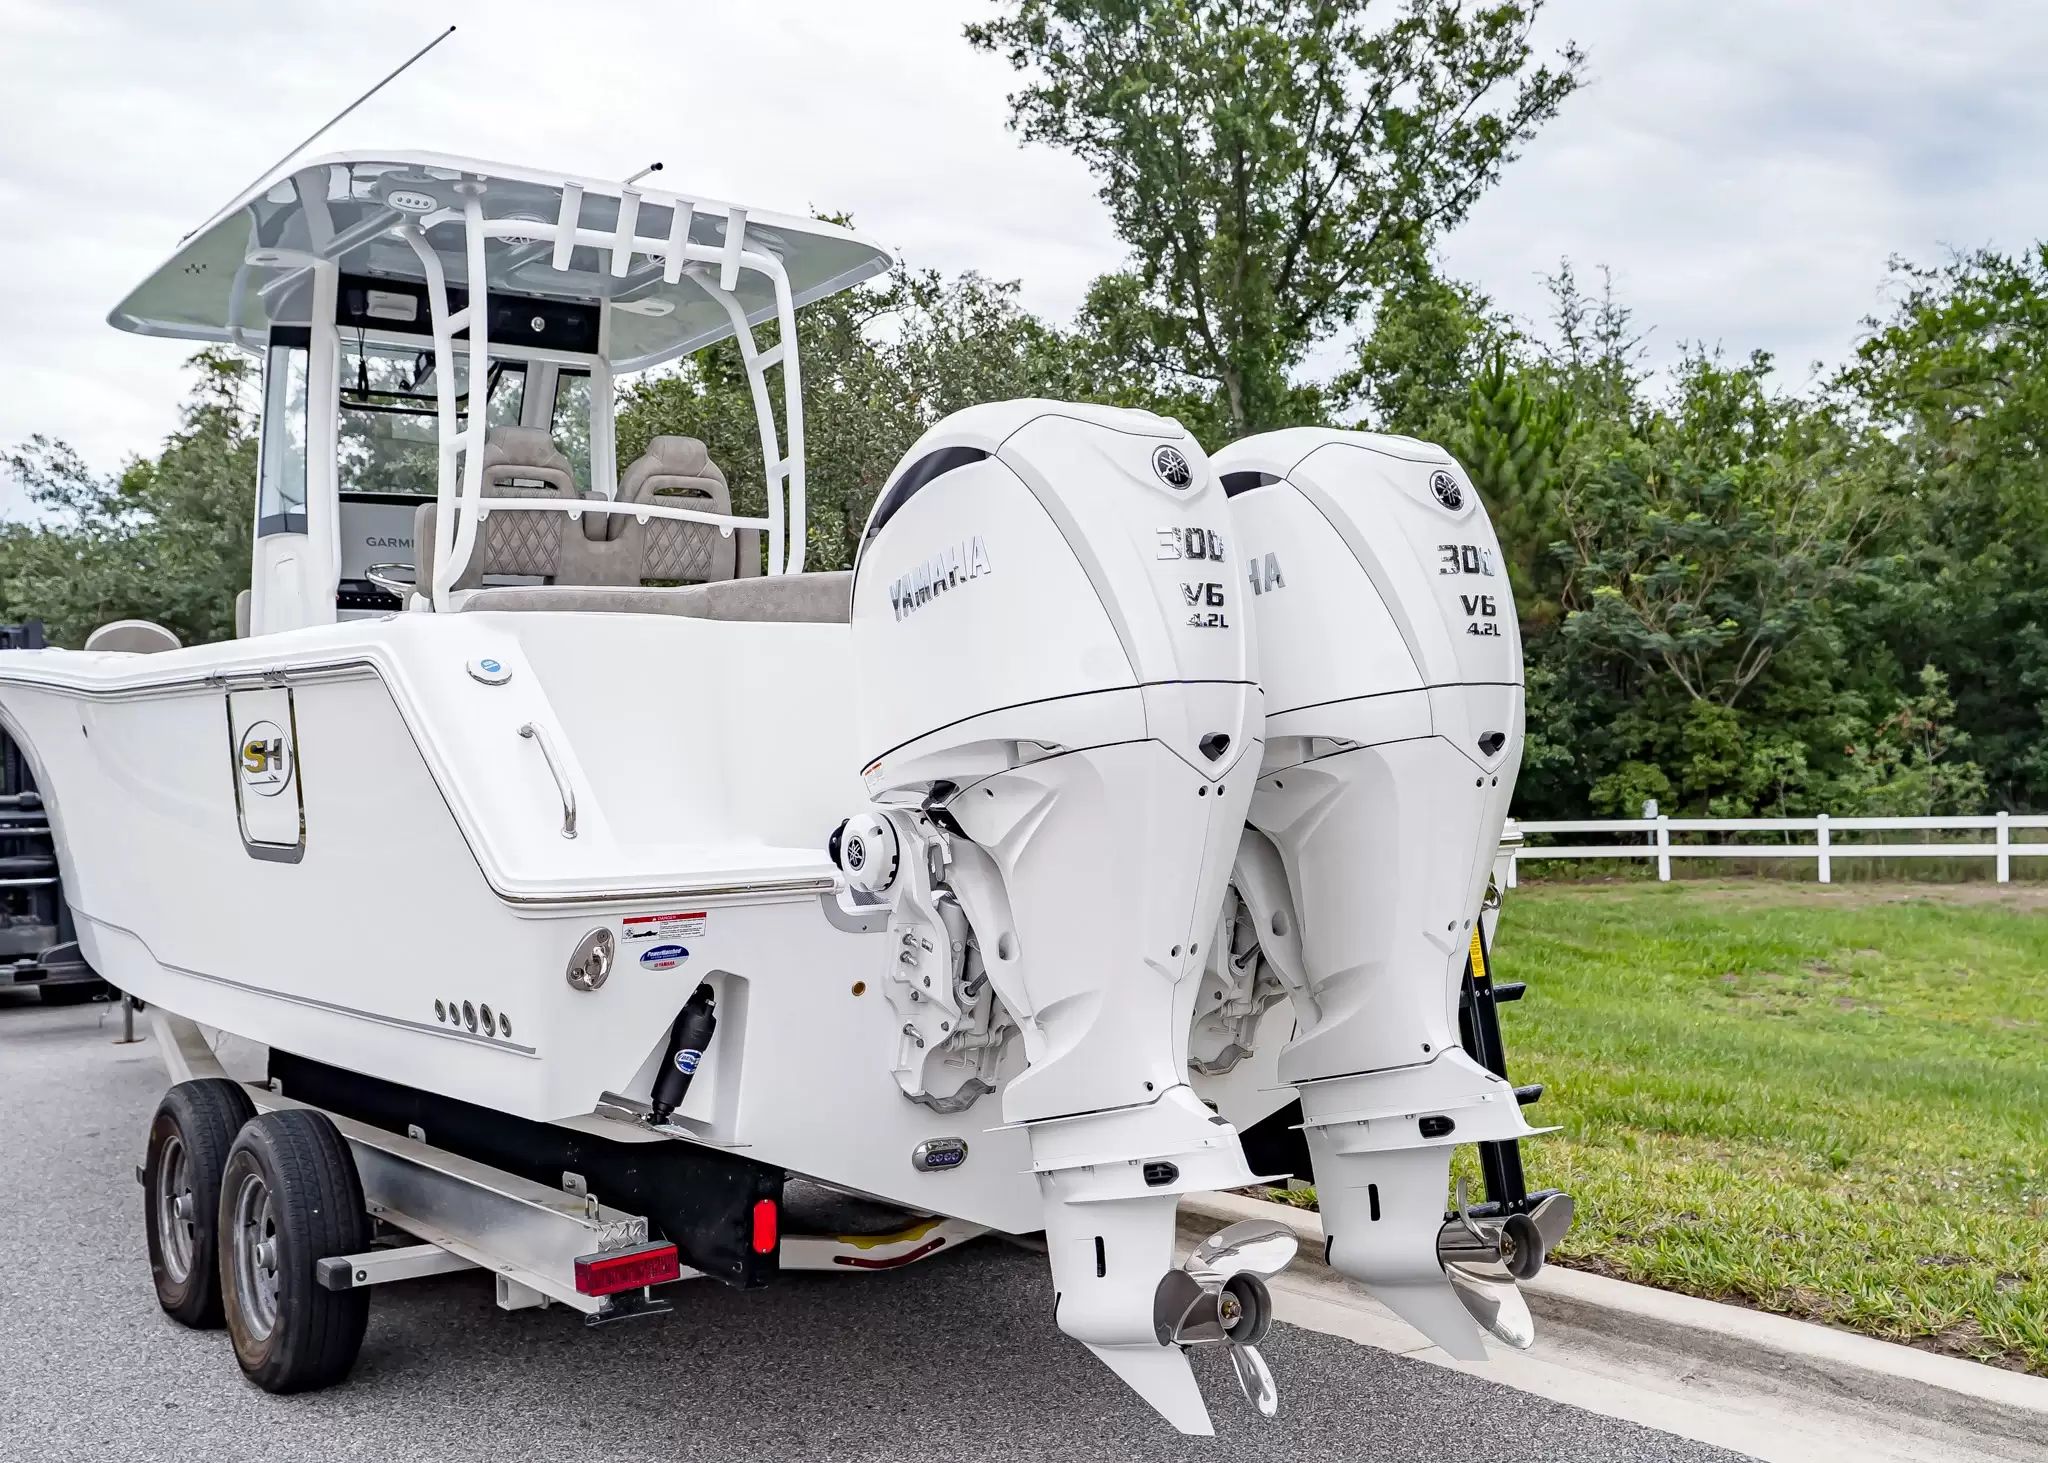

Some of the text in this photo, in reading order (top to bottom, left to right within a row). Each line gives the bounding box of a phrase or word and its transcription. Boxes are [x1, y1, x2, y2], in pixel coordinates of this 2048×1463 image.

[366, 536, 415, 549] GARMI
[1156, 527, 1225, 562] 300
[1437, 544, 1495, 577] 300
[889, 536, 992, 622] YAMAHA
[1180, 582, 1225, 606] V6
[1460, 594, 1497, 616] V6
[1186, 613, 1229, 629] 4.2L
[1466, 622, 1502, 637] 4.2L
